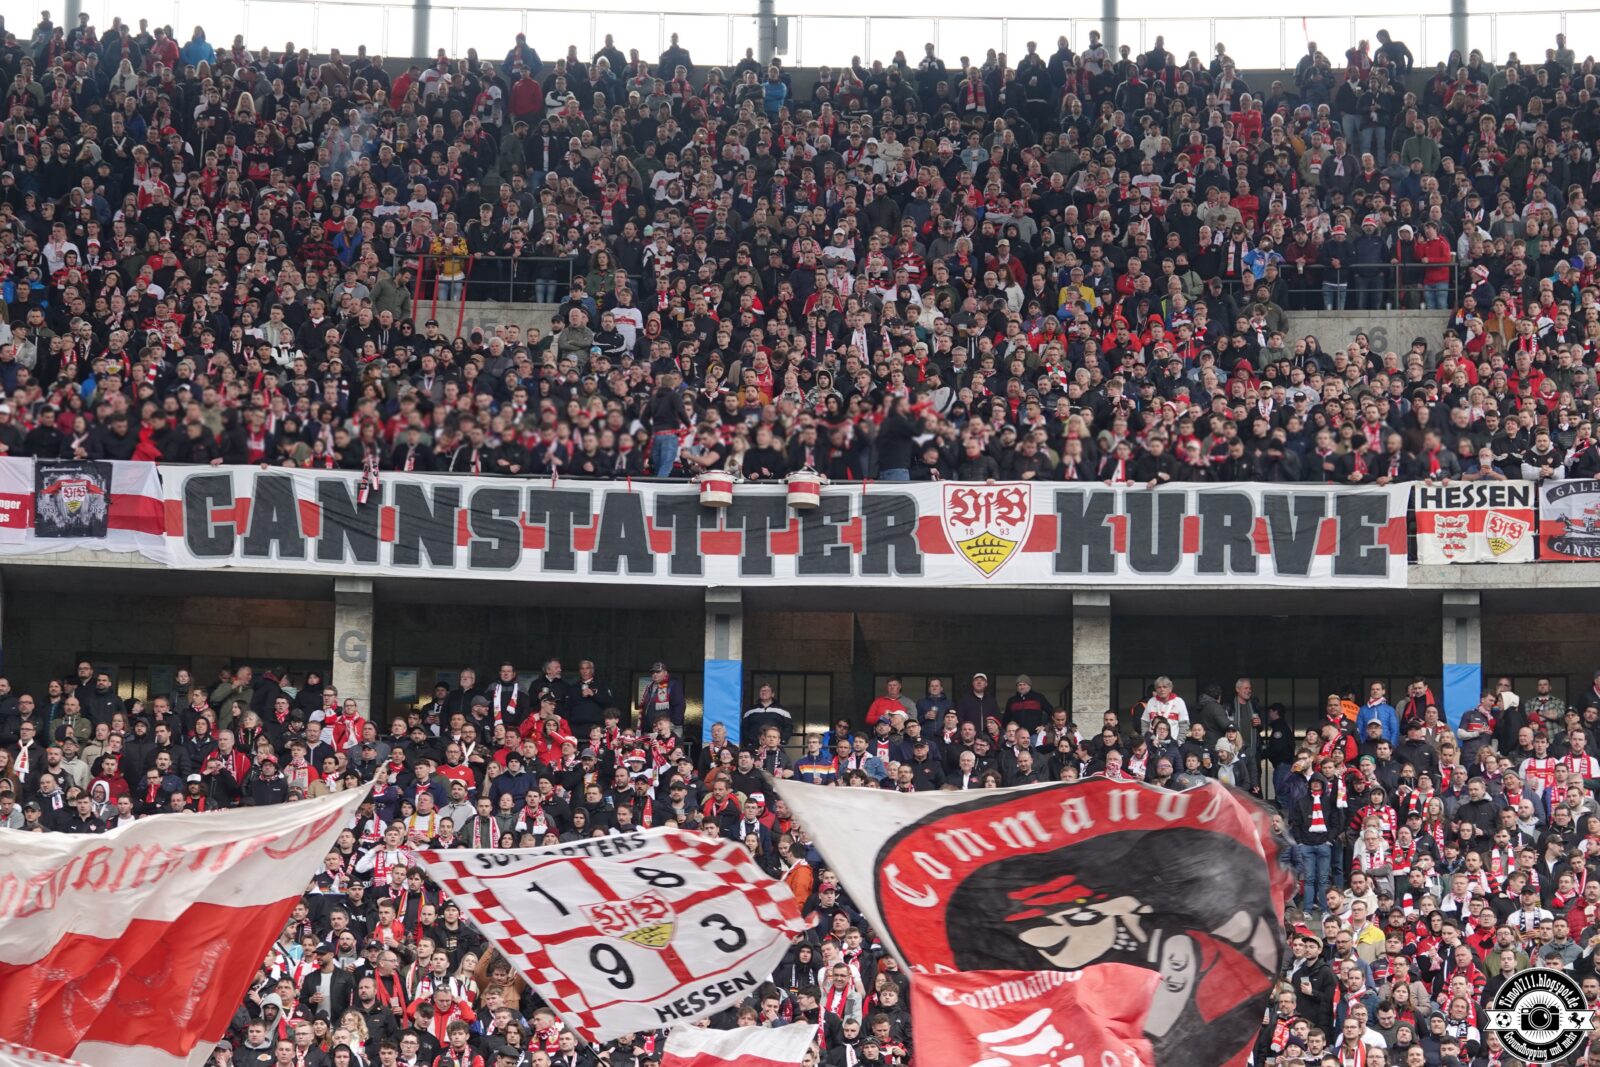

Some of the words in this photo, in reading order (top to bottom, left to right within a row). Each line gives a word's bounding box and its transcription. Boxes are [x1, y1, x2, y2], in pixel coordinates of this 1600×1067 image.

[1420, 484, 1529, 509] HESSEN
[182, 470, 925, 578] CANNSTATTER
[1052, 488, 1391, 578] KURVE
[338, 630, 368, 663] G
[653, 970, 758, 1023] HESSEN
